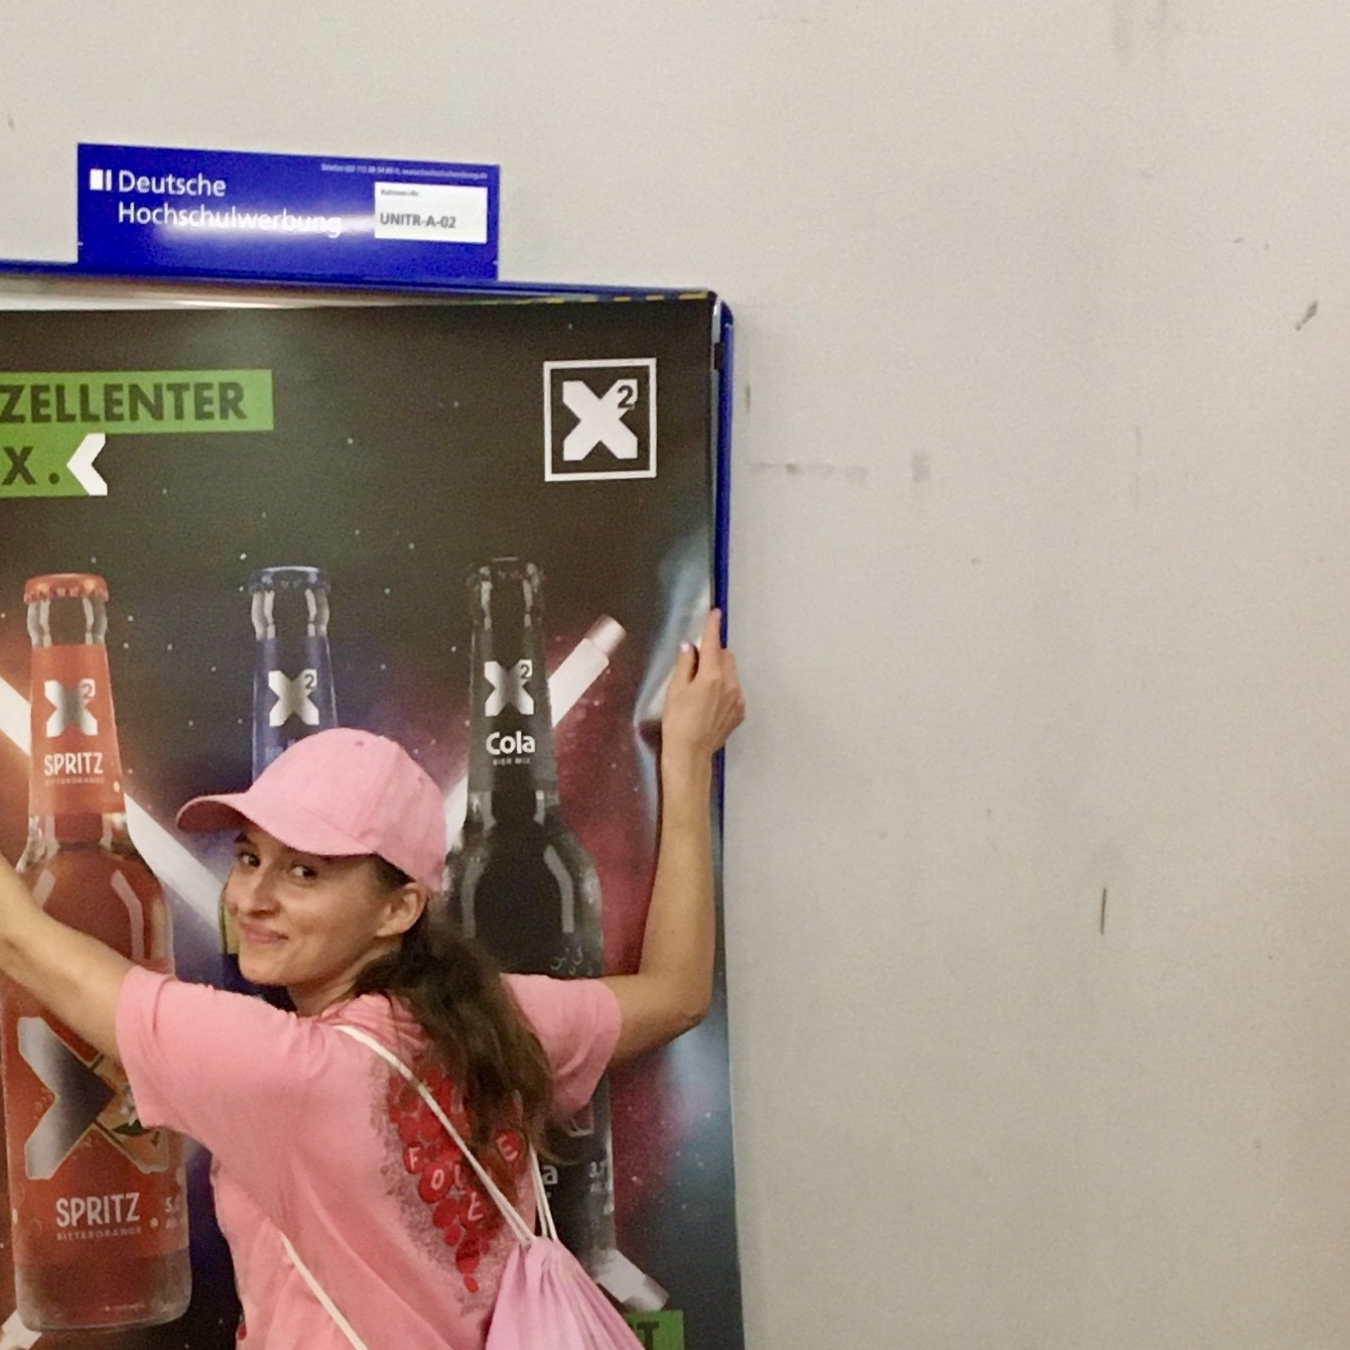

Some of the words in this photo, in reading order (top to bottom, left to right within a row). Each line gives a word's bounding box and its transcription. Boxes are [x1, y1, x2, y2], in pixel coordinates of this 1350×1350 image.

[117, 169, 227, 198] Deutsche
[117, 201, 343, 239] Hochschulwerbung
[379, 212, 457, 229] UNITR-A-02
[486, 731, 536, 755] Cola
[43, 751, 104, 776] SPRITZ
[56, 1192, 141, 1228] SPRITZ
